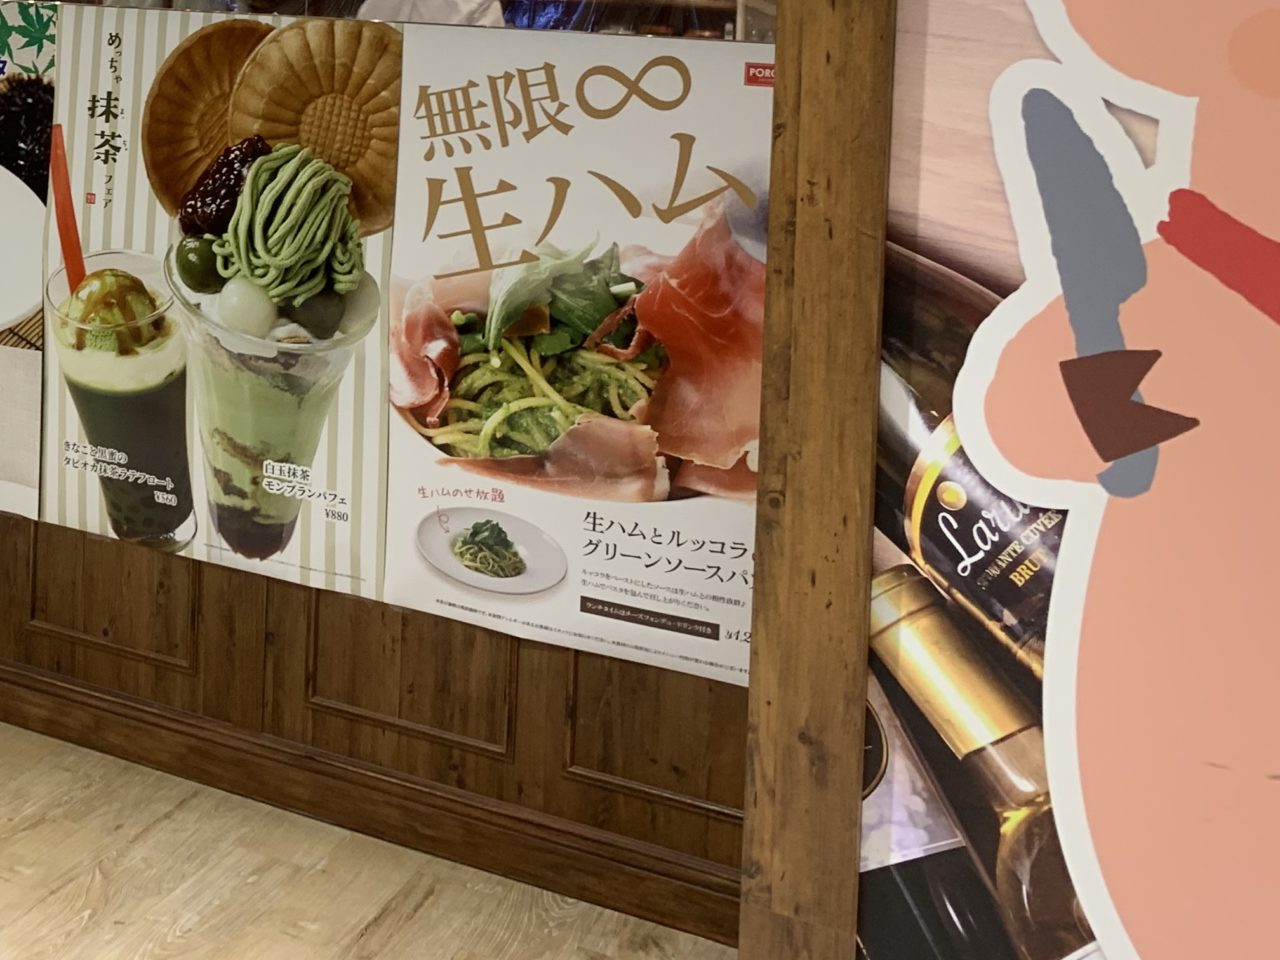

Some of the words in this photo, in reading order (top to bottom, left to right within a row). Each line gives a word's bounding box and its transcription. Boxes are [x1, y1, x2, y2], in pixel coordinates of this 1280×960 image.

[421, 132, 758, 280] 生ハム
[63, 440, 129, 464] きなこと黒蜜の
[264, 461, 311, 481] 白玉抹茶
[264, 480, 348, 506] モンブランパフェ
[417, 485, 506, 503] 生ハムのせ放題
[324, 507, 349, 522] ¥880
[582, 510, 757, 562] 生ハムとルッコラ
[581, 538, 755, 590] グリーンソースパ
[1008, 546, 1049, 588] BRUT
